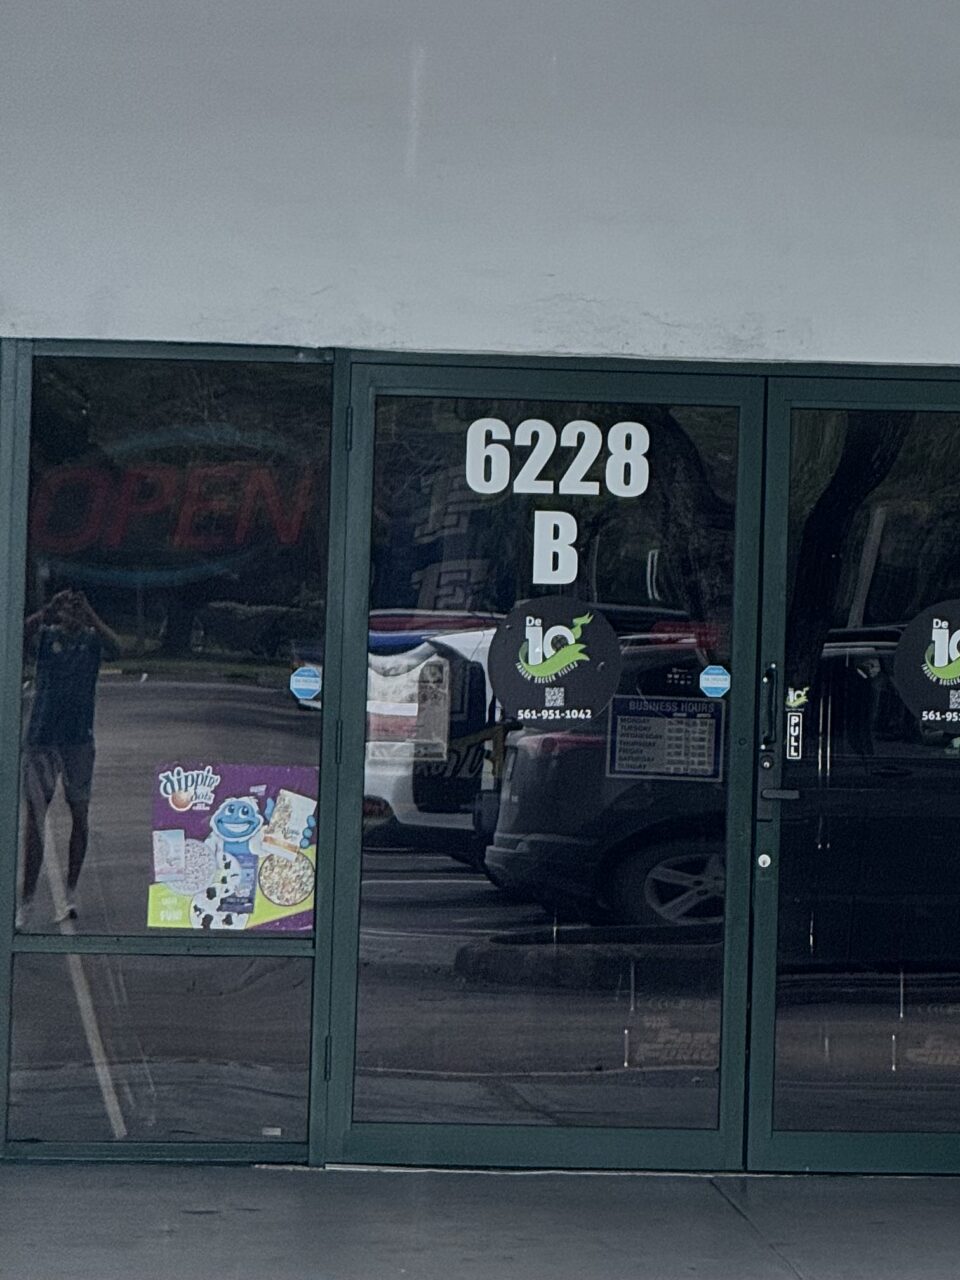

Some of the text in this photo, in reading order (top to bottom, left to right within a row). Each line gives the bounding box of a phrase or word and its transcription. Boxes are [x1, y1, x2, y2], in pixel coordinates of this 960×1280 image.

[465, 417, 651, 498] 6228
[29, 462, 314, 552] OPEN
[532, 510, 579, 585] B
[525, 616, 542, 627] De
[932, 618, 949, 629] De
[517, 709, 592, 720] 561-951-1042
[628, 700, 715, 713] BUSINESS HOURS
[790, 716, 799, 757] PULL
